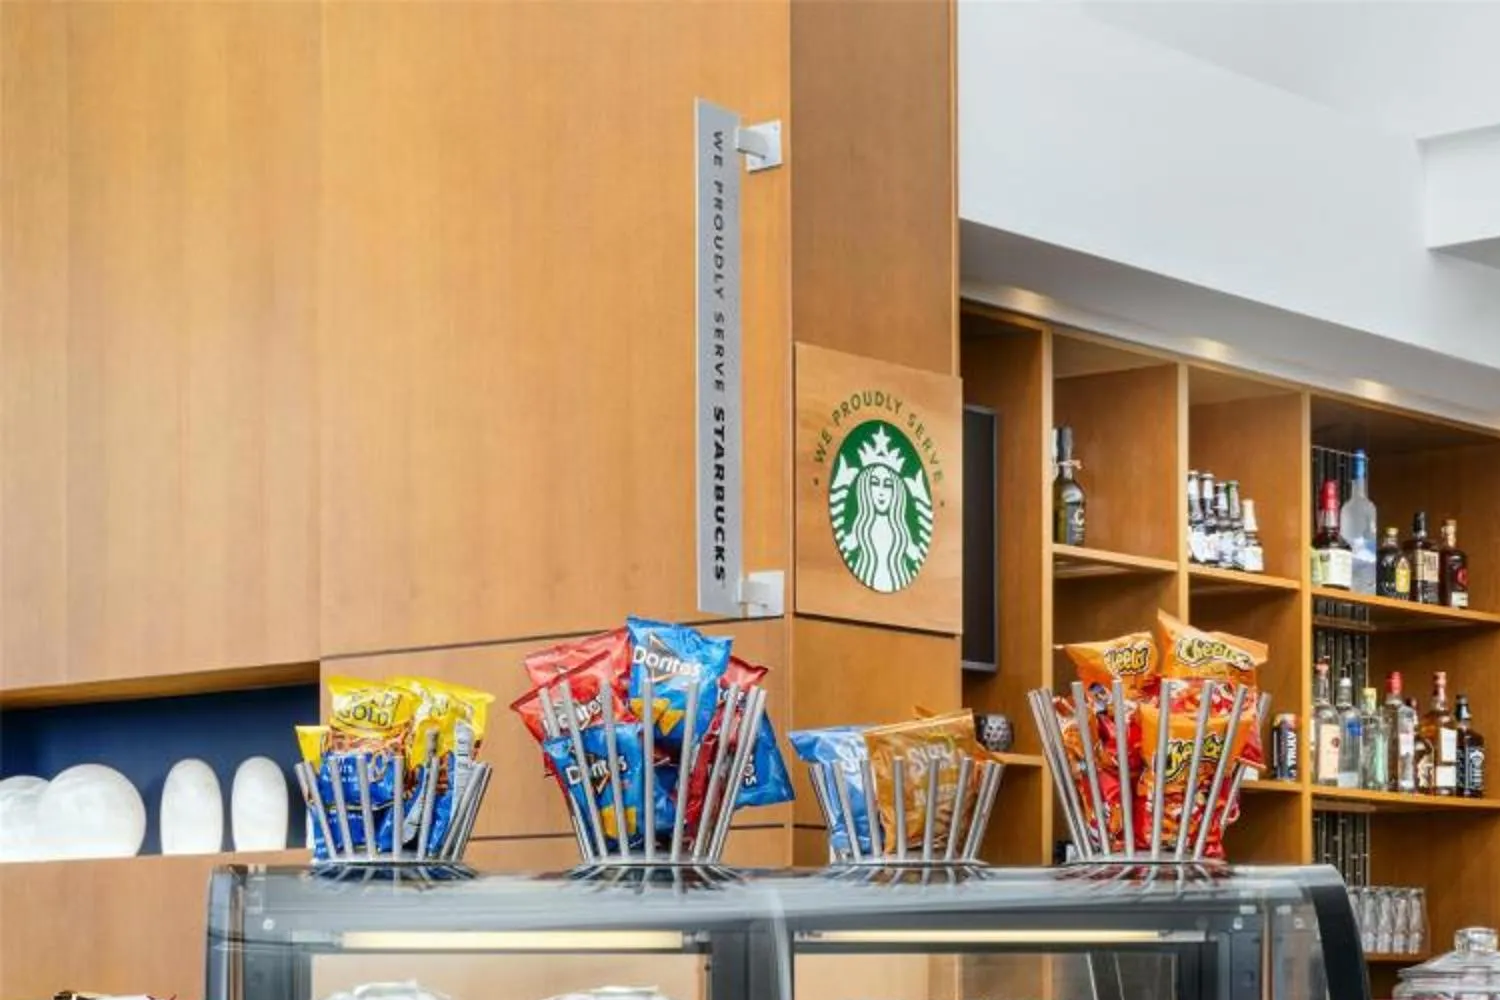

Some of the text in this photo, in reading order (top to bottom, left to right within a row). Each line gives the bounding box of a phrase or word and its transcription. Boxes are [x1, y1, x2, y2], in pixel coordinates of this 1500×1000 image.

[713, 130, 726, 582] WE PROUDLY SERVE STARBUCKS
[814, 390, 944, 482] WE PROUDLY SERVE
[633, 645, 707, 678] Doritos
